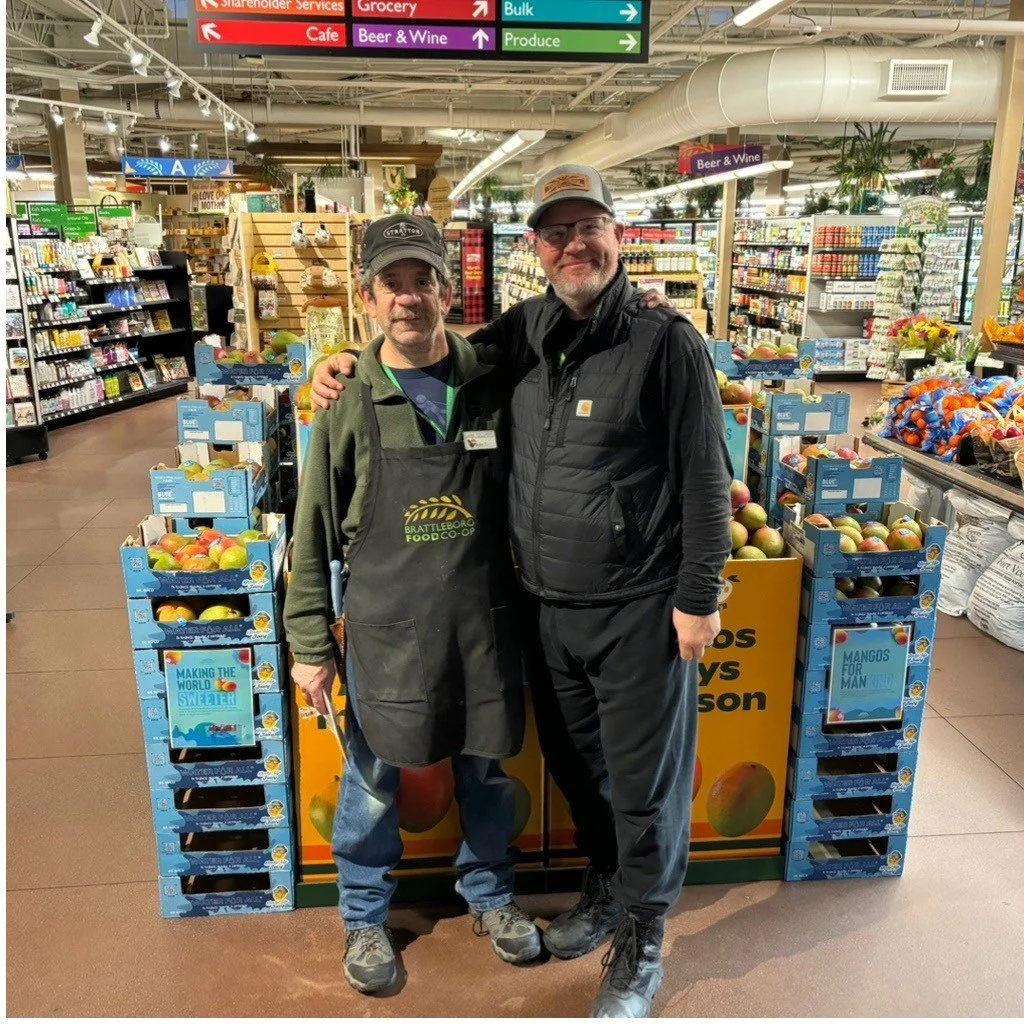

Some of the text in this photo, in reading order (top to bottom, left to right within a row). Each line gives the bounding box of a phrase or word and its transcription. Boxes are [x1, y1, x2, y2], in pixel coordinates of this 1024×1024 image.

[221, 0, 344, 12] Shareholder Services
[357, 0, 417, 17] Grocery
[504, 2, 534, 17] Bulk
[306, 27, 339, 42] Cafe
[358, 29, 448, 45] Beer & Wine
[504, 33, 561, 48] Produce
[171, 160, 187, 175] A
[697, 152, 761, 170] Beer & Wine
[199, 191, 214, 200] LOVE
[405, 518, 475, 534] BRATTLEBORO
[405, 527, 476, 543] FOOD CO-OP
[712, 628, 756, 649] os
[842, 649, 890, 664] MANGOS
[176, 666, 236, 679] MAKING THE
[698, 660, 740, 686] ys
[841, 663, 862, 676] FOR
[177, 680, 211, 691] WORLD
[178, 692, 236, 707] SWEETER
[698, 690, 766, 712] son
